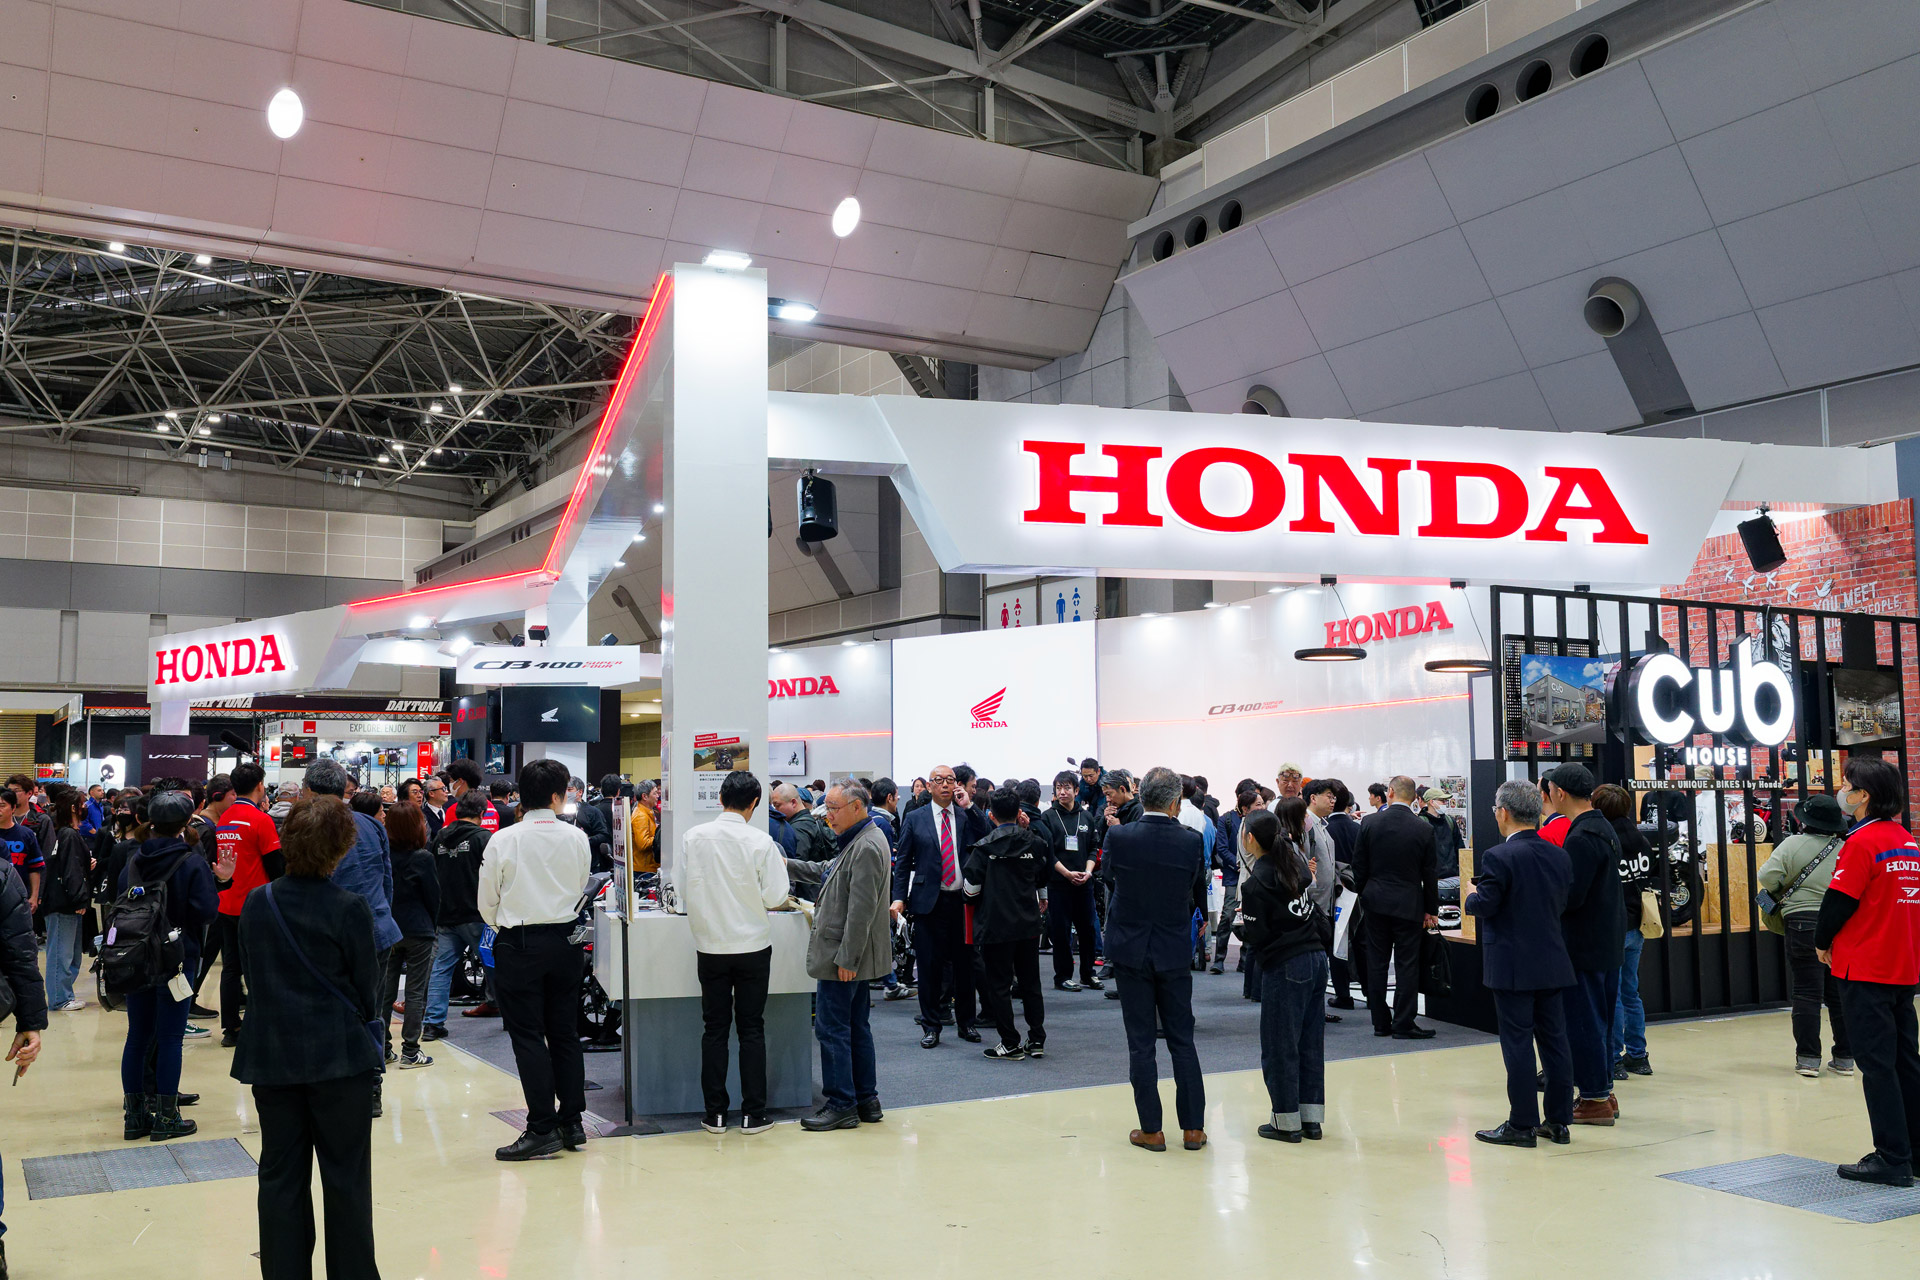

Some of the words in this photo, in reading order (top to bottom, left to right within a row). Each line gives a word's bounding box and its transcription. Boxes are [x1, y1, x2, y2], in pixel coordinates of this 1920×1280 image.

[1022, 440, 1649, 545] HONDA
[1843, 581, 1878, 608] MEET
[1324, 600, 1453, 649] HONDA
[155, 634, 286, 685] HONDA
[768, 675, 840, 699] ONDA
[1638, 635, 1795, 746] Cub
[385, 700, 445, 712] DAYTONA
[384, 724, 408, 733] ENJOY.
[971, 721, 1008, 729] HONDA
[1685, 747, 1747, 766] HOUSE
[1631, 780, 1668, 789] CULTURE
[1677, 780, 1707, 789] UNIQUE
[1716, 780, 1740, 789] BIKES
[1747, 781, 1756, 790] by
[1758, 781, 1782, 789] Honda
[1886, 860, 1920, 872] HOND
